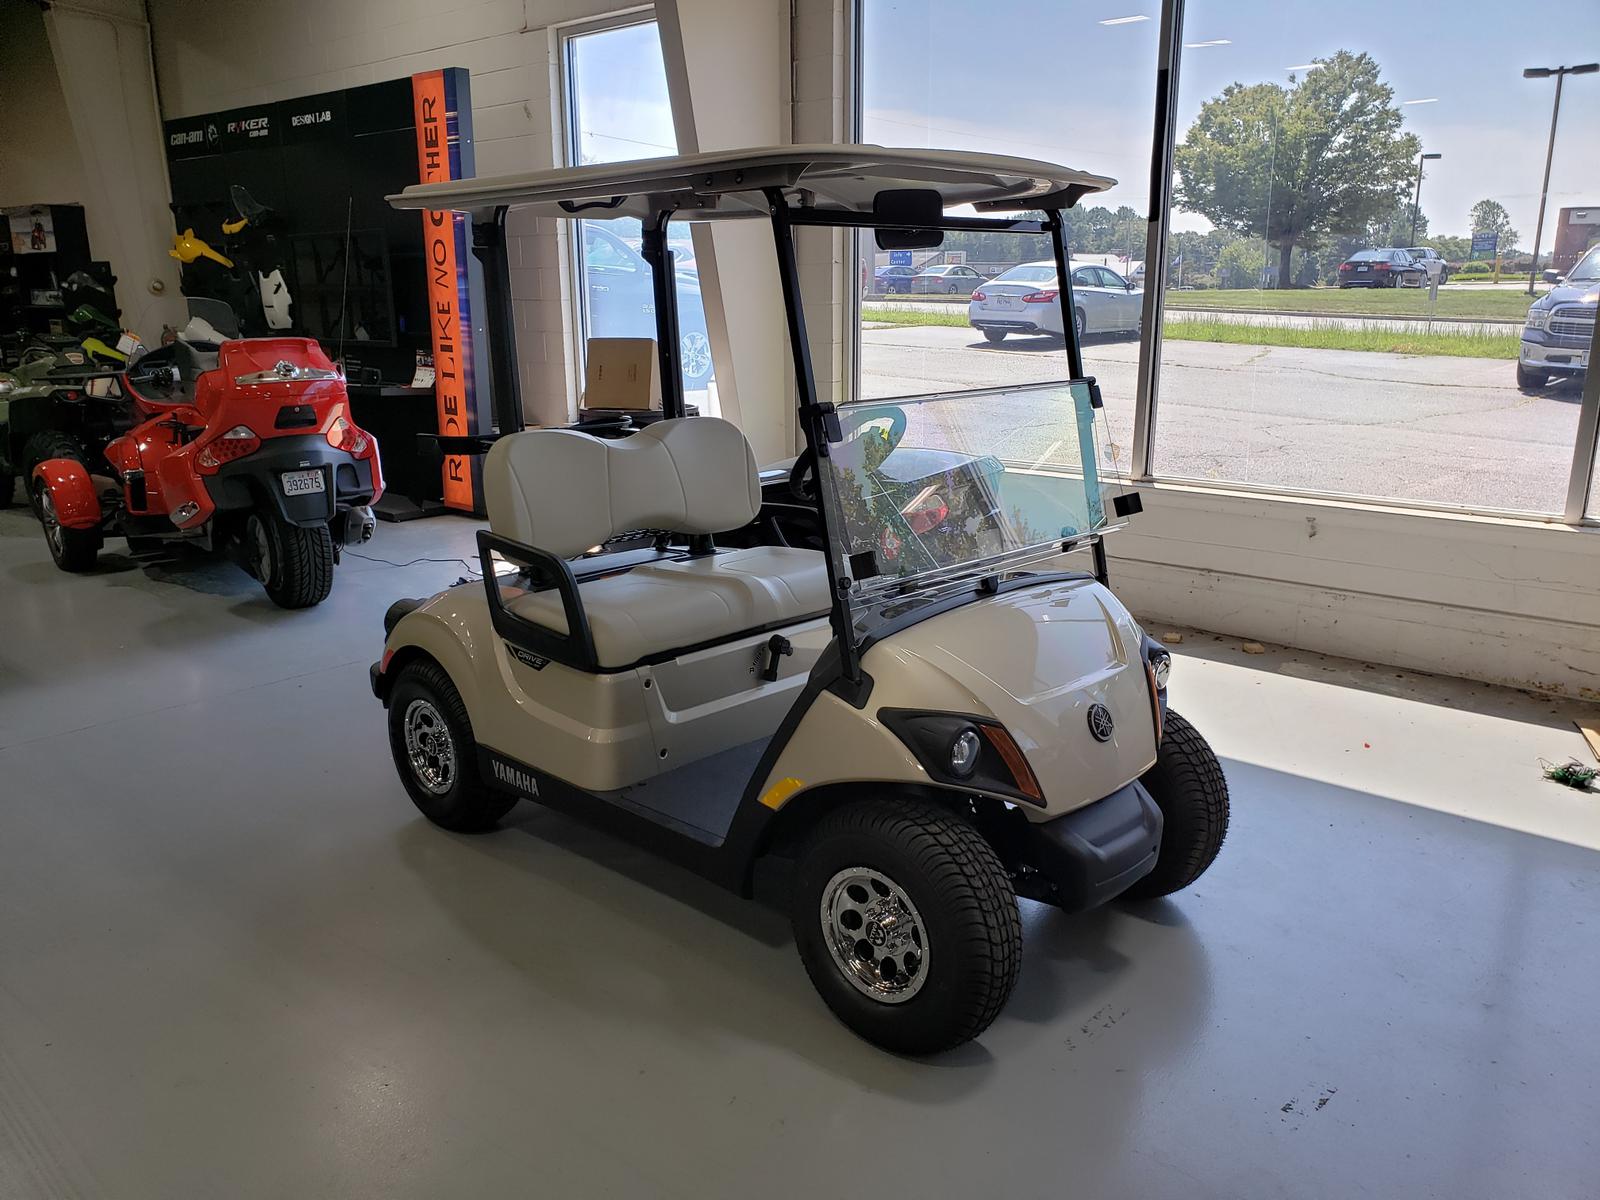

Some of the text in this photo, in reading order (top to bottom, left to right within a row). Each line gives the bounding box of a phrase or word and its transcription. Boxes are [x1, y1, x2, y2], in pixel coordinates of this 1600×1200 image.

[291, 111, 332, 127] DESIGN LAB
[170, 130, 203, 146] can-am
[422, 96, 463, 482] RDE LIKE NO OHER
[286, 478, 321, 491] 392675
[492, 759, 540, 797] YAMAHA
